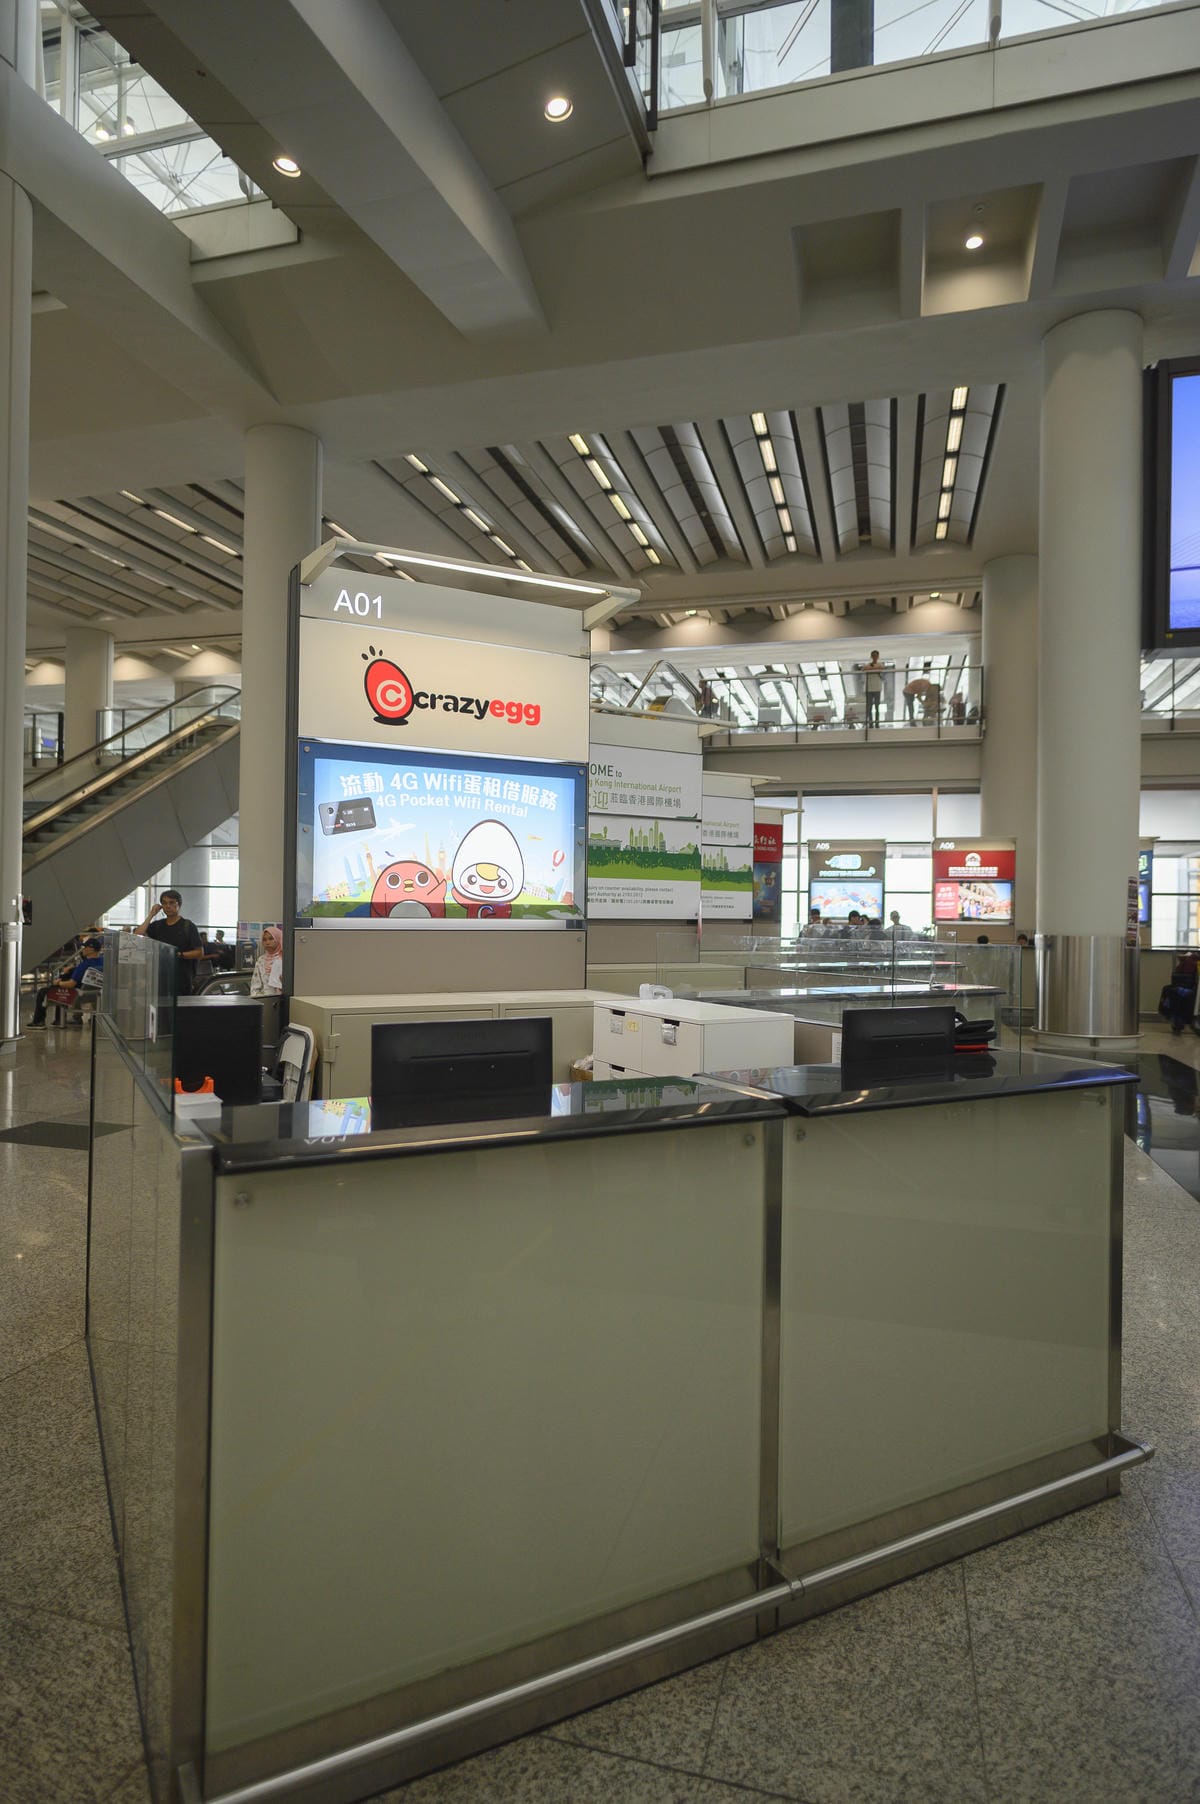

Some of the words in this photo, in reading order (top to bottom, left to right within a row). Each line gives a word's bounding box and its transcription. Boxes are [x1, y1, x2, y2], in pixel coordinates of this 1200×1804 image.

[333, 589, 384, 619] A01
[413, 690, 541, 726] crazyegg
[590, 763, 614, 777] OME
[615, 769, 622, 778] to
[339, 772, 385, 797] 流動
[390, 772, 419, 791] 4G
[594, 778, 613, 789] Kong
[614, 779, 657, 791] International
[658, 784, 682, 794] Airport
[376, 794, 397, 808] 4G
[400, 793, 450, 807] Pocket
[454, 795, 481, 810] Wifi
[484, 799, 529, 818] Rental
[591, 790, 608, 809] 迎
